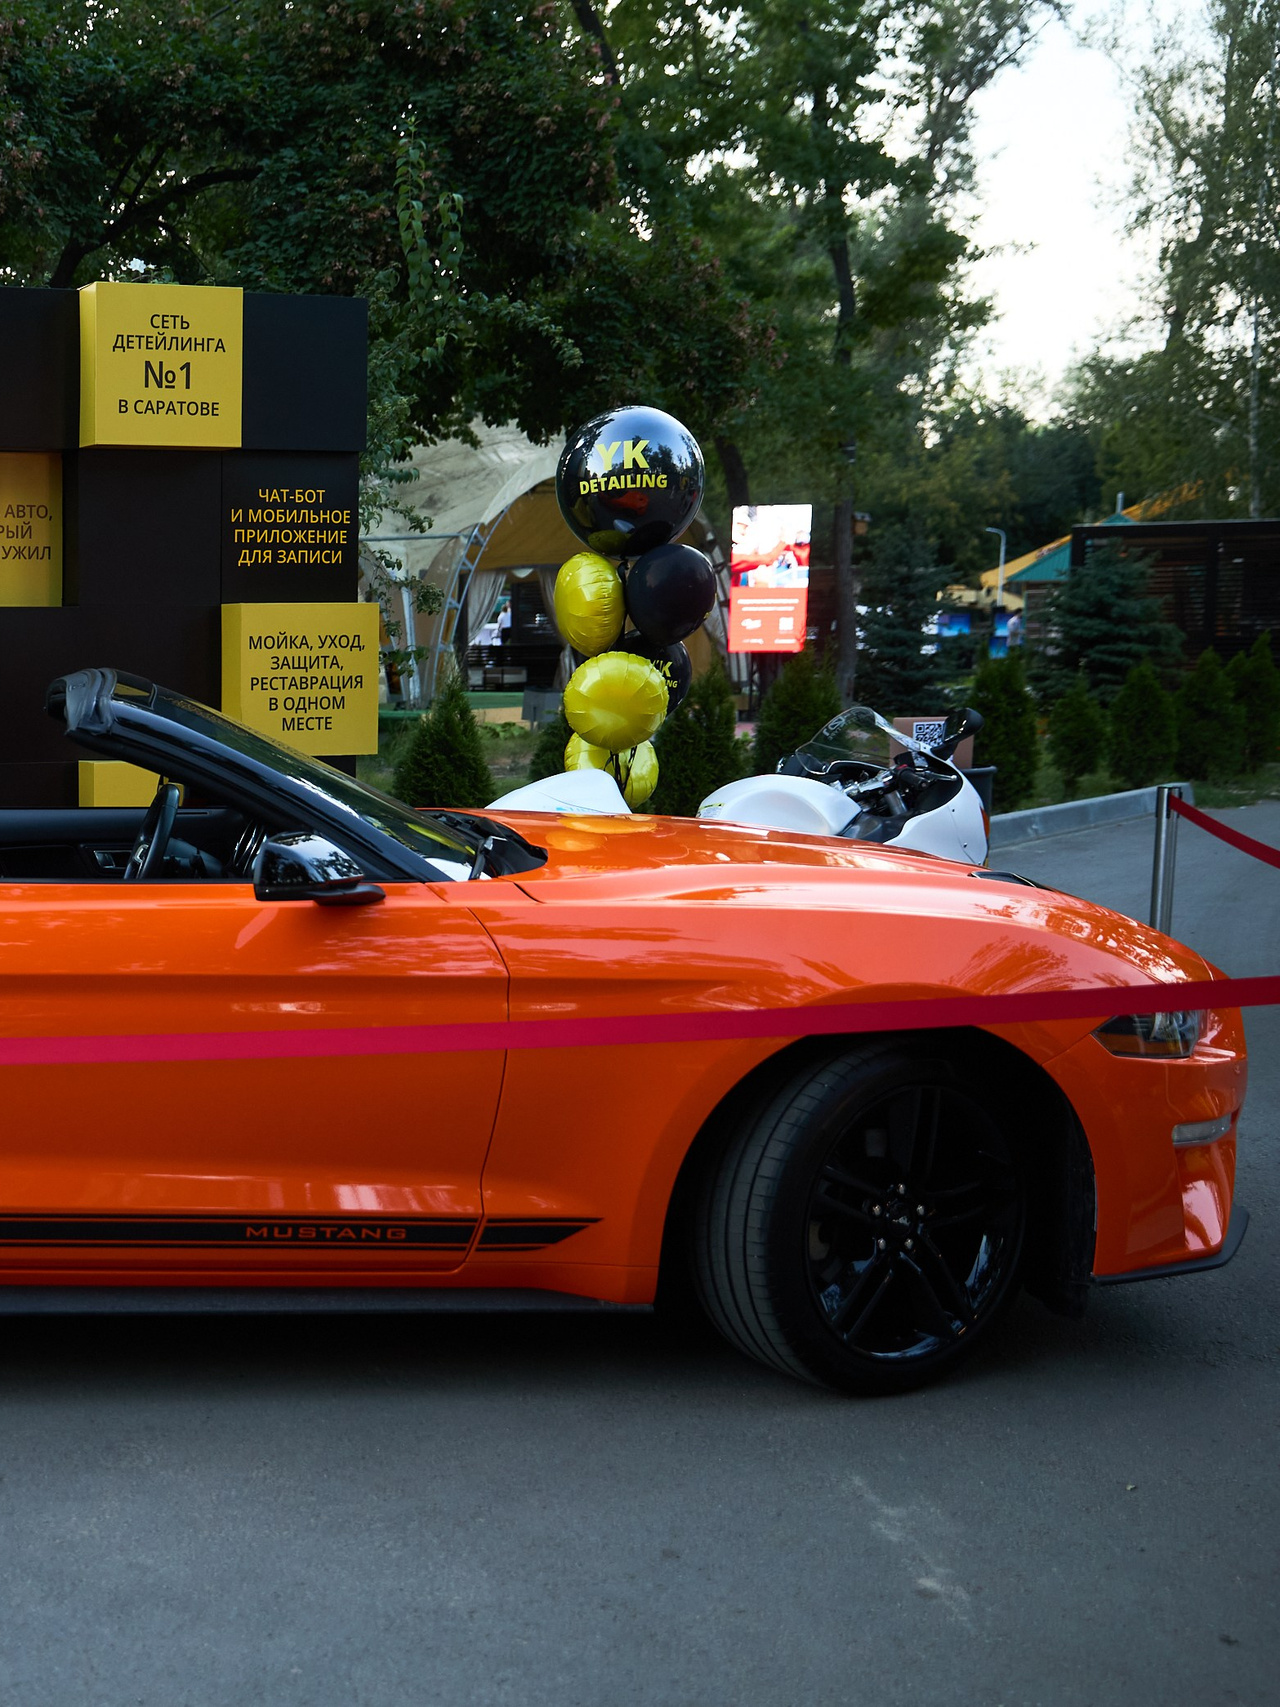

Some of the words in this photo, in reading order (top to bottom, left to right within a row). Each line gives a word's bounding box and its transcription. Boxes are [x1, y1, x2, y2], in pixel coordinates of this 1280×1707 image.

[150, 314, 190, 330] СЕТЬ
[112, 331, 226, 353] ДЕТЕЙЛИНГА
[144, 360, 191, 390] №1
[118, 399, 129, 414] В
[133, 399, 219, 417] САРАТОВЕ
[596, 439, 650, 472] YK
[579, 473, 668, 495] DETAILING
[258, 488, 326, 504] ЧАТ-БОТ
[4, 504, 52, 521] АВТО,
[231, 508, 243, 523] И
[248, 508, 351, 524] МОБИЛЬНОЕ
[234, 529, 348, 544] ПРИЛОЖЕНИЕ
[238, 549, 272, 567] ДЛЯ
[277, 549, 342, 564] ЗАПИСИ
[248, 631, 314, 652] МОЙКА,
[318, 634, 366, 652] УХОД,
[270, 655, 344, 673] ЗАЩИТА,
[250, 675, 363, 692] РЕСТАВРАЦИЯ
[269, 697, 279, 711] В
[283, 695, 345, 714] ОДНОМ
[282, 716, 333, 731] МЕСТЕ
[246, 1226, 407, 1240] MUSTANG
